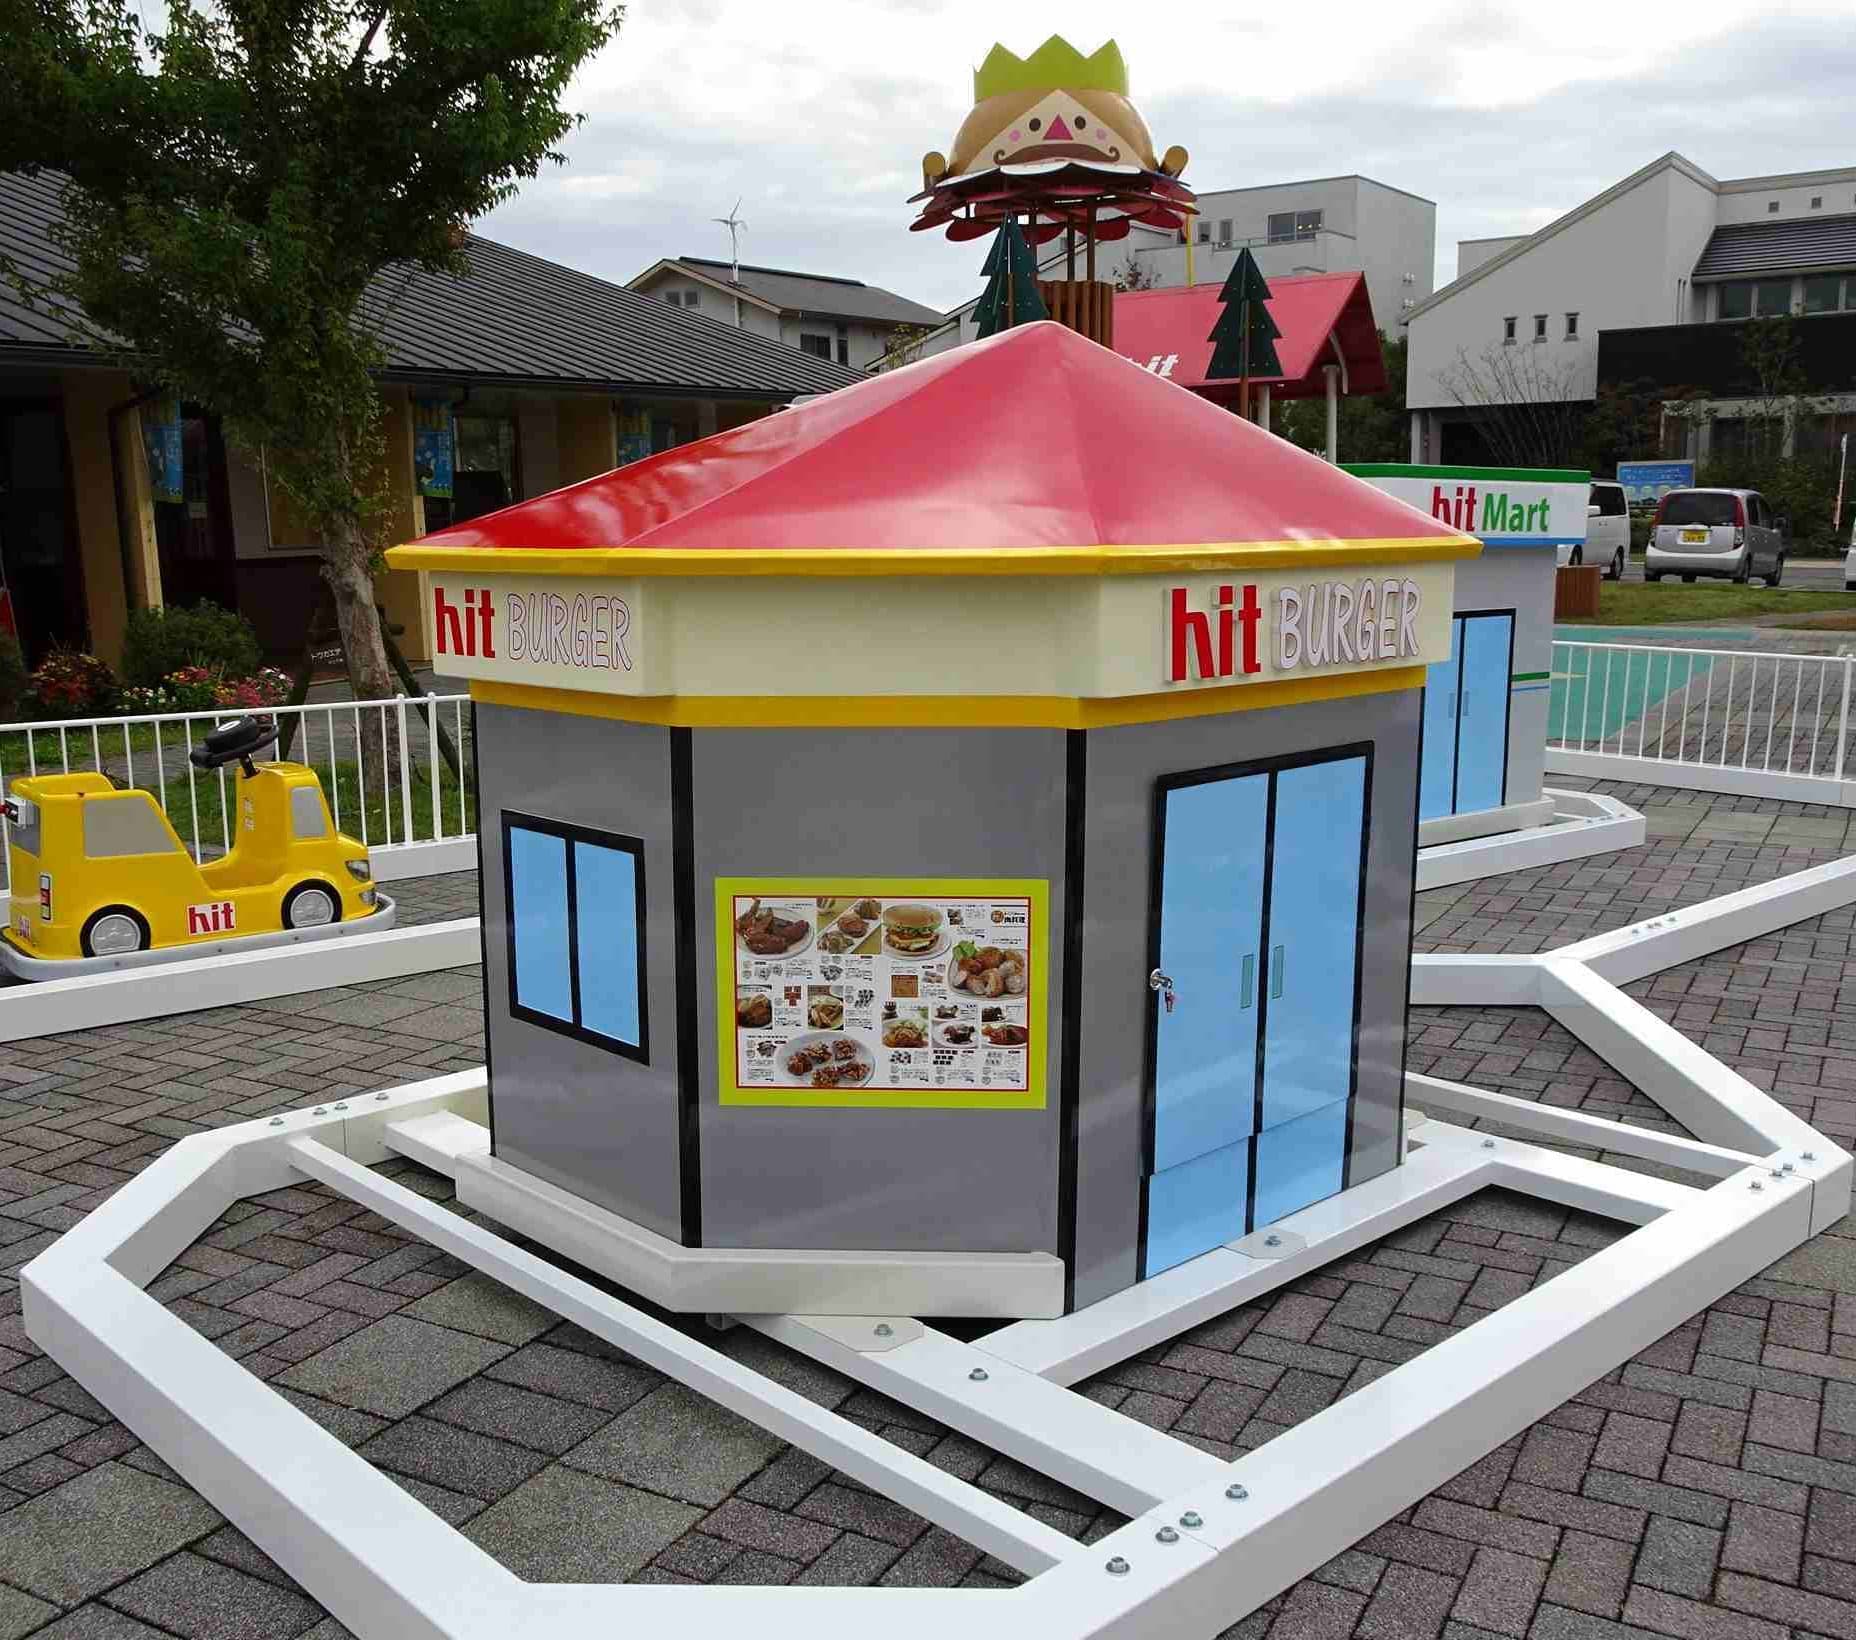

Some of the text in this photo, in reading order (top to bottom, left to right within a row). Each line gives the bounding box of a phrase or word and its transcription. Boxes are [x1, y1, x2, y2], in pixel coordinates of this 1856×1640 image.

[1432, 486, 1550, 532] hit Mart
[434, 587, 632, 671] hit BURGER
[1171, 576, 1423, 682] hit BURGER
[188, 902, 236, 934] hit
